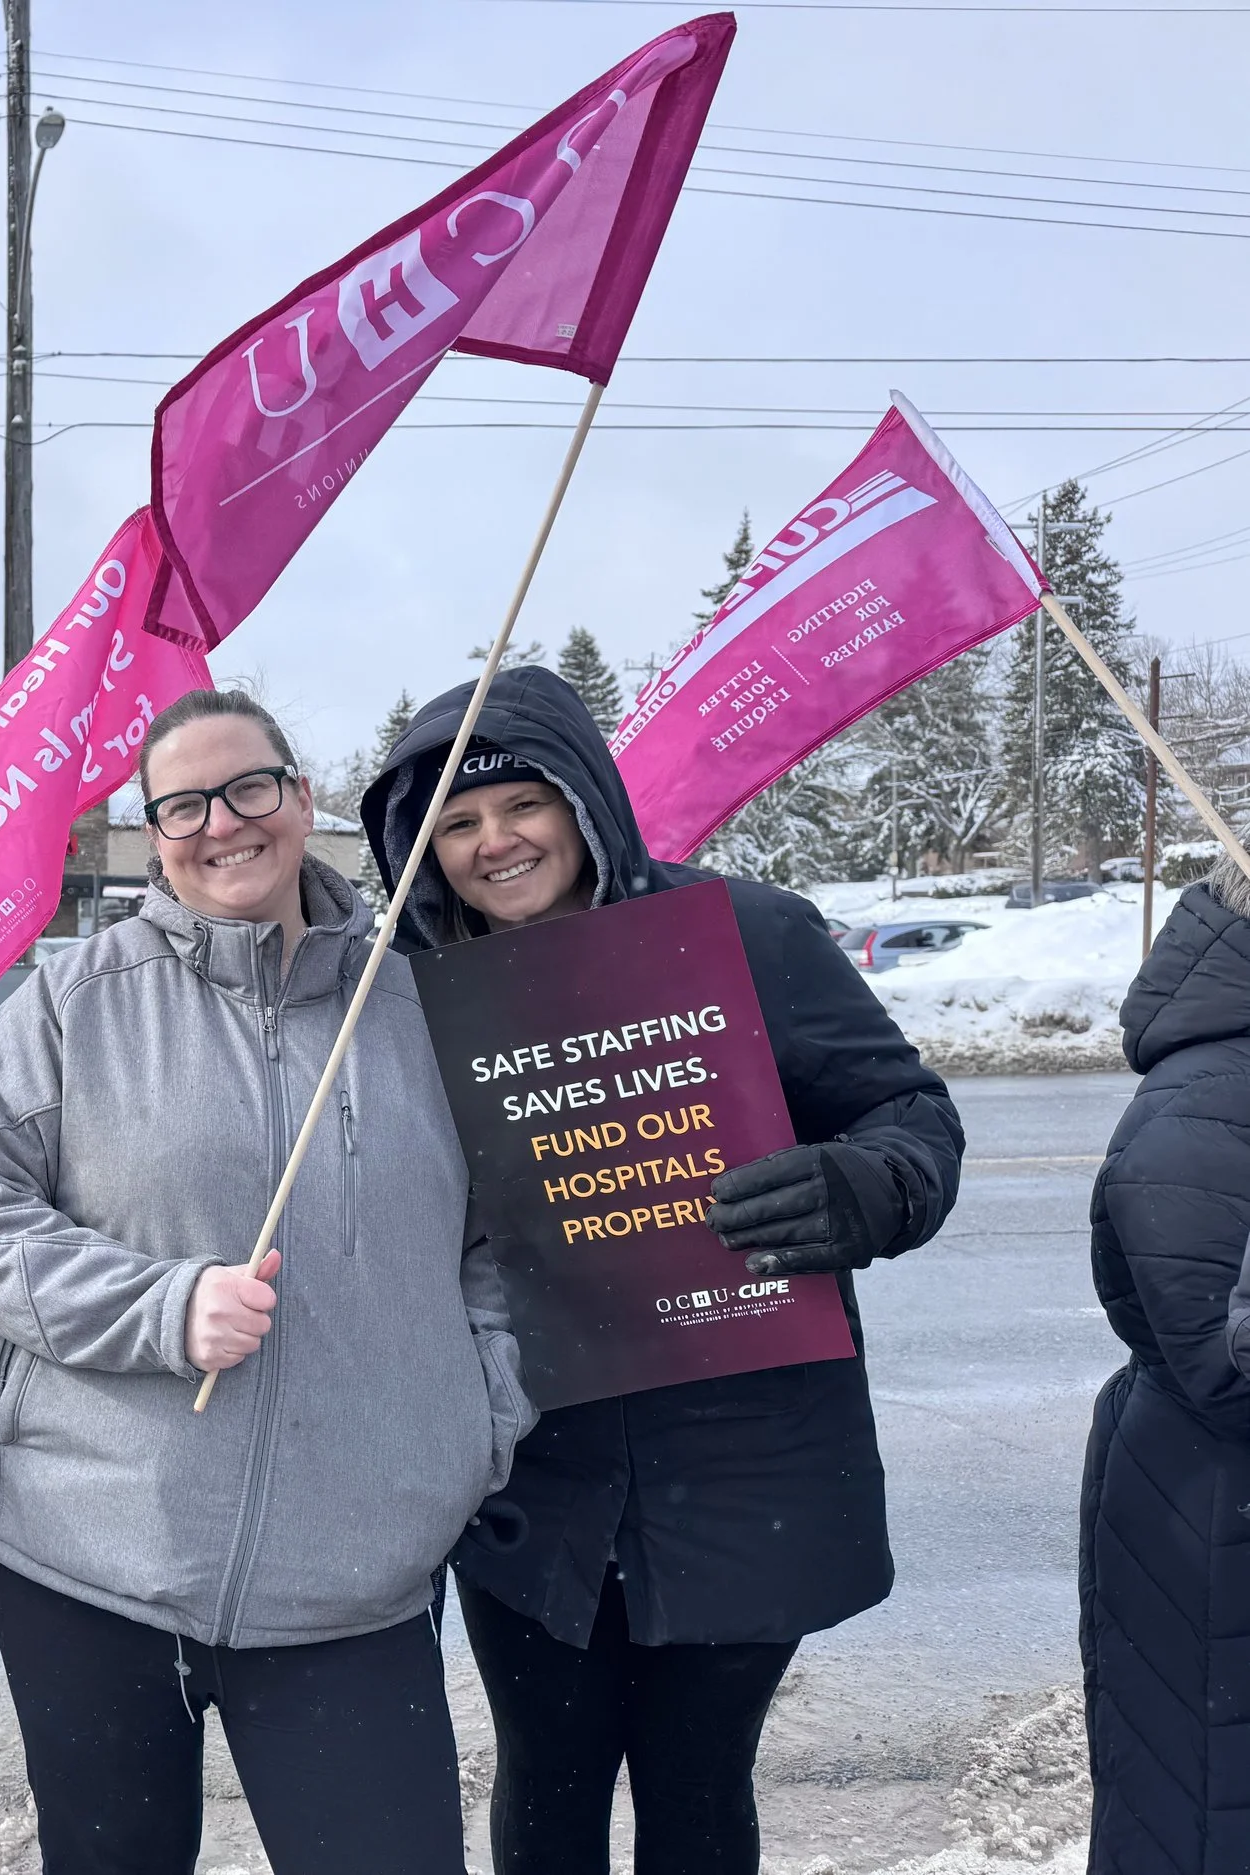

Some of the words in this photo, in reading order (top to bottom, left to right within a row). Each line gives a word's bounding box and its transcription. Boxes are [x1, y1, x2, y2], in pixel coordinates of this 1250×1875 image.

[463, 753, 528, 774] CUPE
[471, 1043, 555, 1083] SAFE
[561, 1005, 727, 1063] STAFFING
[503, 1078, 606, 1121] SAVES
[614, 1056, 718, 1099] LIVES.
[531, 1121, 627, 1161] FUND
[636, 1103, 716, 1140] OUR
[543, 1148, 726, 1203] HOSPITALS
[562, 1195, 719, 1245] PROPERL
